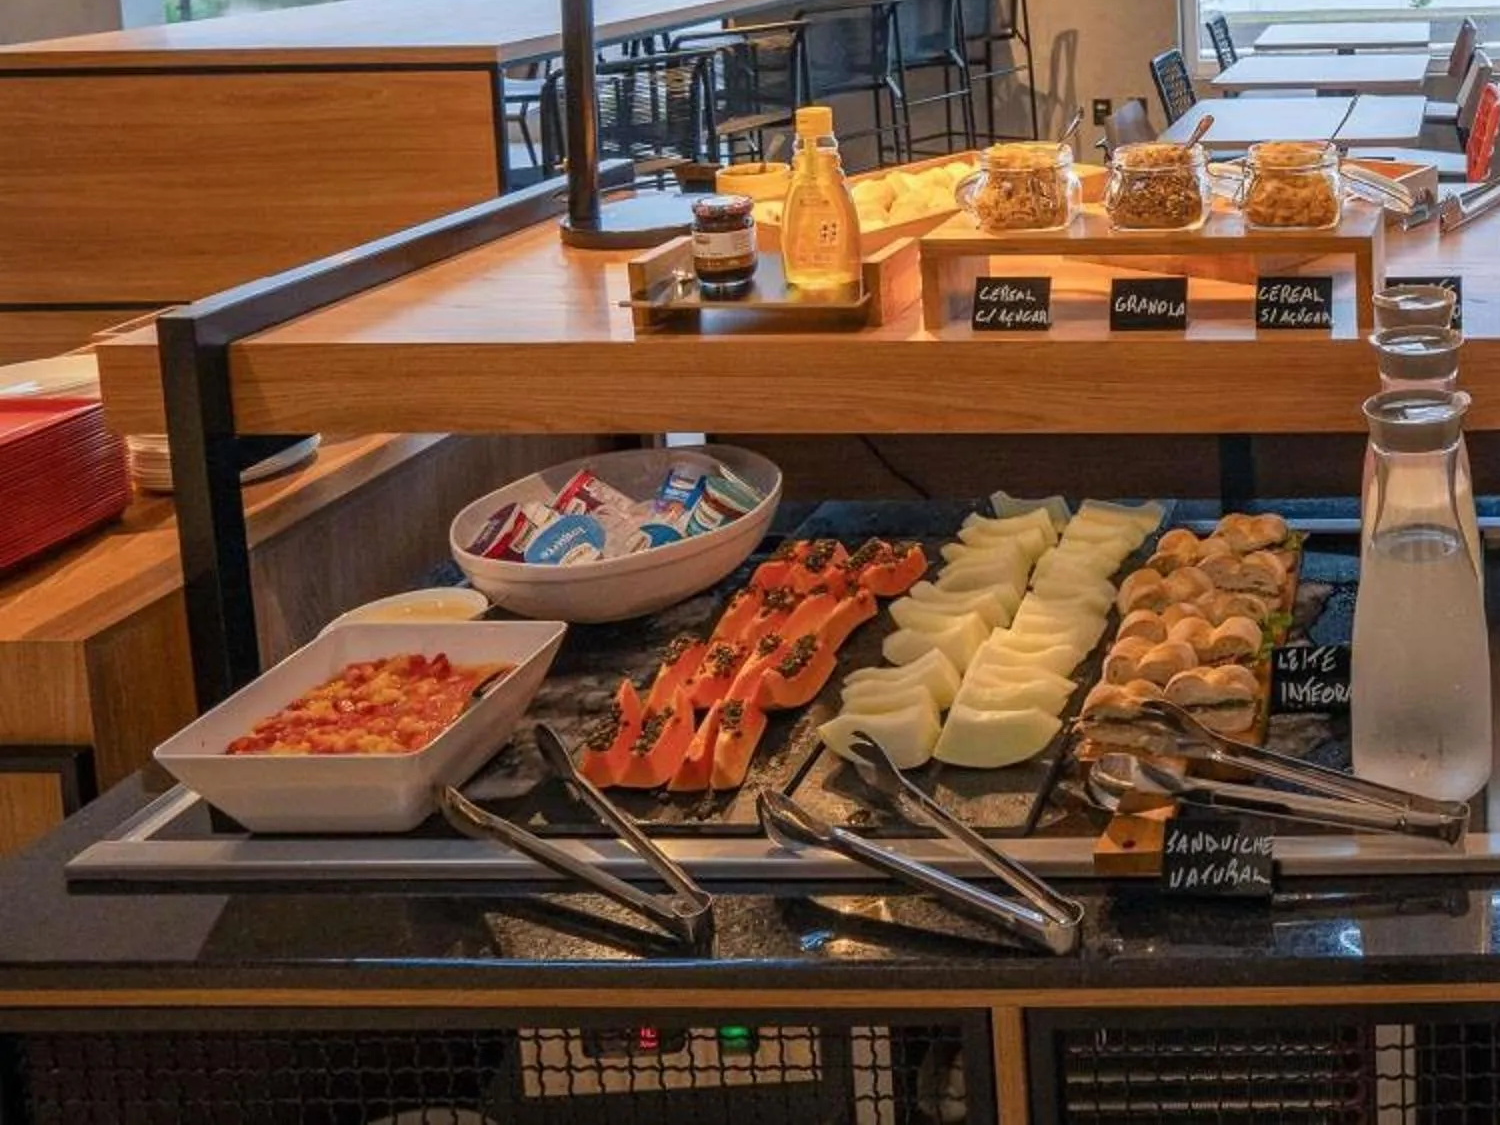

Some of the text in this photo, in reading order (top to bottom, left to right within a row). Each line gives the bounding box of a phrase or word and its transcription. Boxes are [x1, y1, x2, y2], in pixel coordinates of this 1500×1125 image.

[979, 284, 1036, 302] CEREAL
[1258, 283, 1325, 304] CEREAL
[1115, 293, 1186, 318] GRANOLA
[1277, 645, 1338, 673] LEITE
